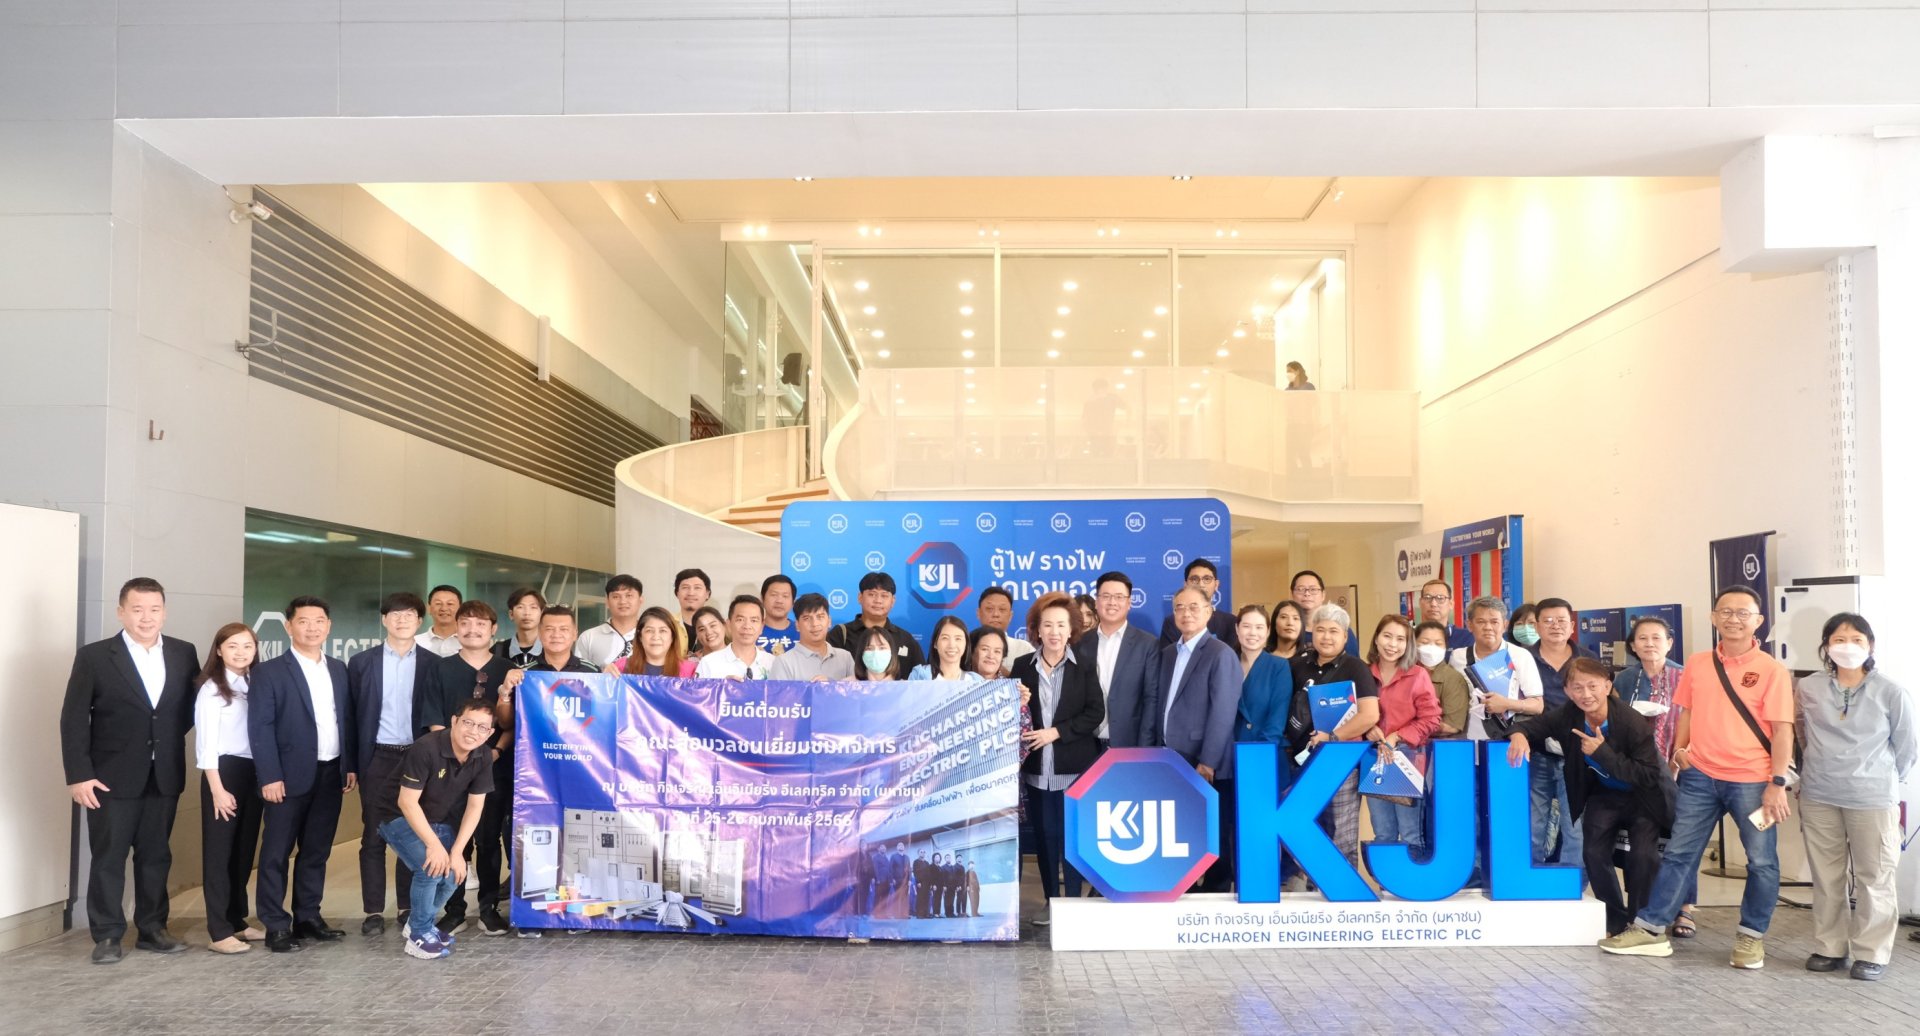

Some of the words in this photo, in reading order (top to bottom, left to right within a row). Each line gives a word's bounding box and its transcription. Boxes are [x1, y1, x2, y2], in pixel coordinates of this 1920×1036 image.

[990, 548, 1035, 578] ตู้ไฟ
[1040, 549, 1106, 571] รางไฟ
[918, 563, 960, 592] KJL
[720, 700, 812, 719] ยินดีต้อนรับ
[978, 727, 1019, 757] PLC
[543, 752, 563, 760] YOUR
[564, 753, 593, 761] WORLD
[839, 783, 871, 797] จำกัด
[1096, 800, 1189, 866] KJL
[1233, 739, 1583, 904] KJL
[1177, 912, 1210, 927] บริษัท
[1214, 912, 1264, 927] กิจเจริญ
[1337, 909, 1391, 924] อีเลคทริค
[1396, 909, 1428, 924] จำกัด
[1432, 910, 1482, 926] (มหาชน)
[1177, 931, 1271, 944] KIJCHAROEN
[1278, 930, 1374, 943] ENGINEERING
[1381, 928, 1448, 941] ELECTRIC
[1455, 928, 1482, 941] PLC
